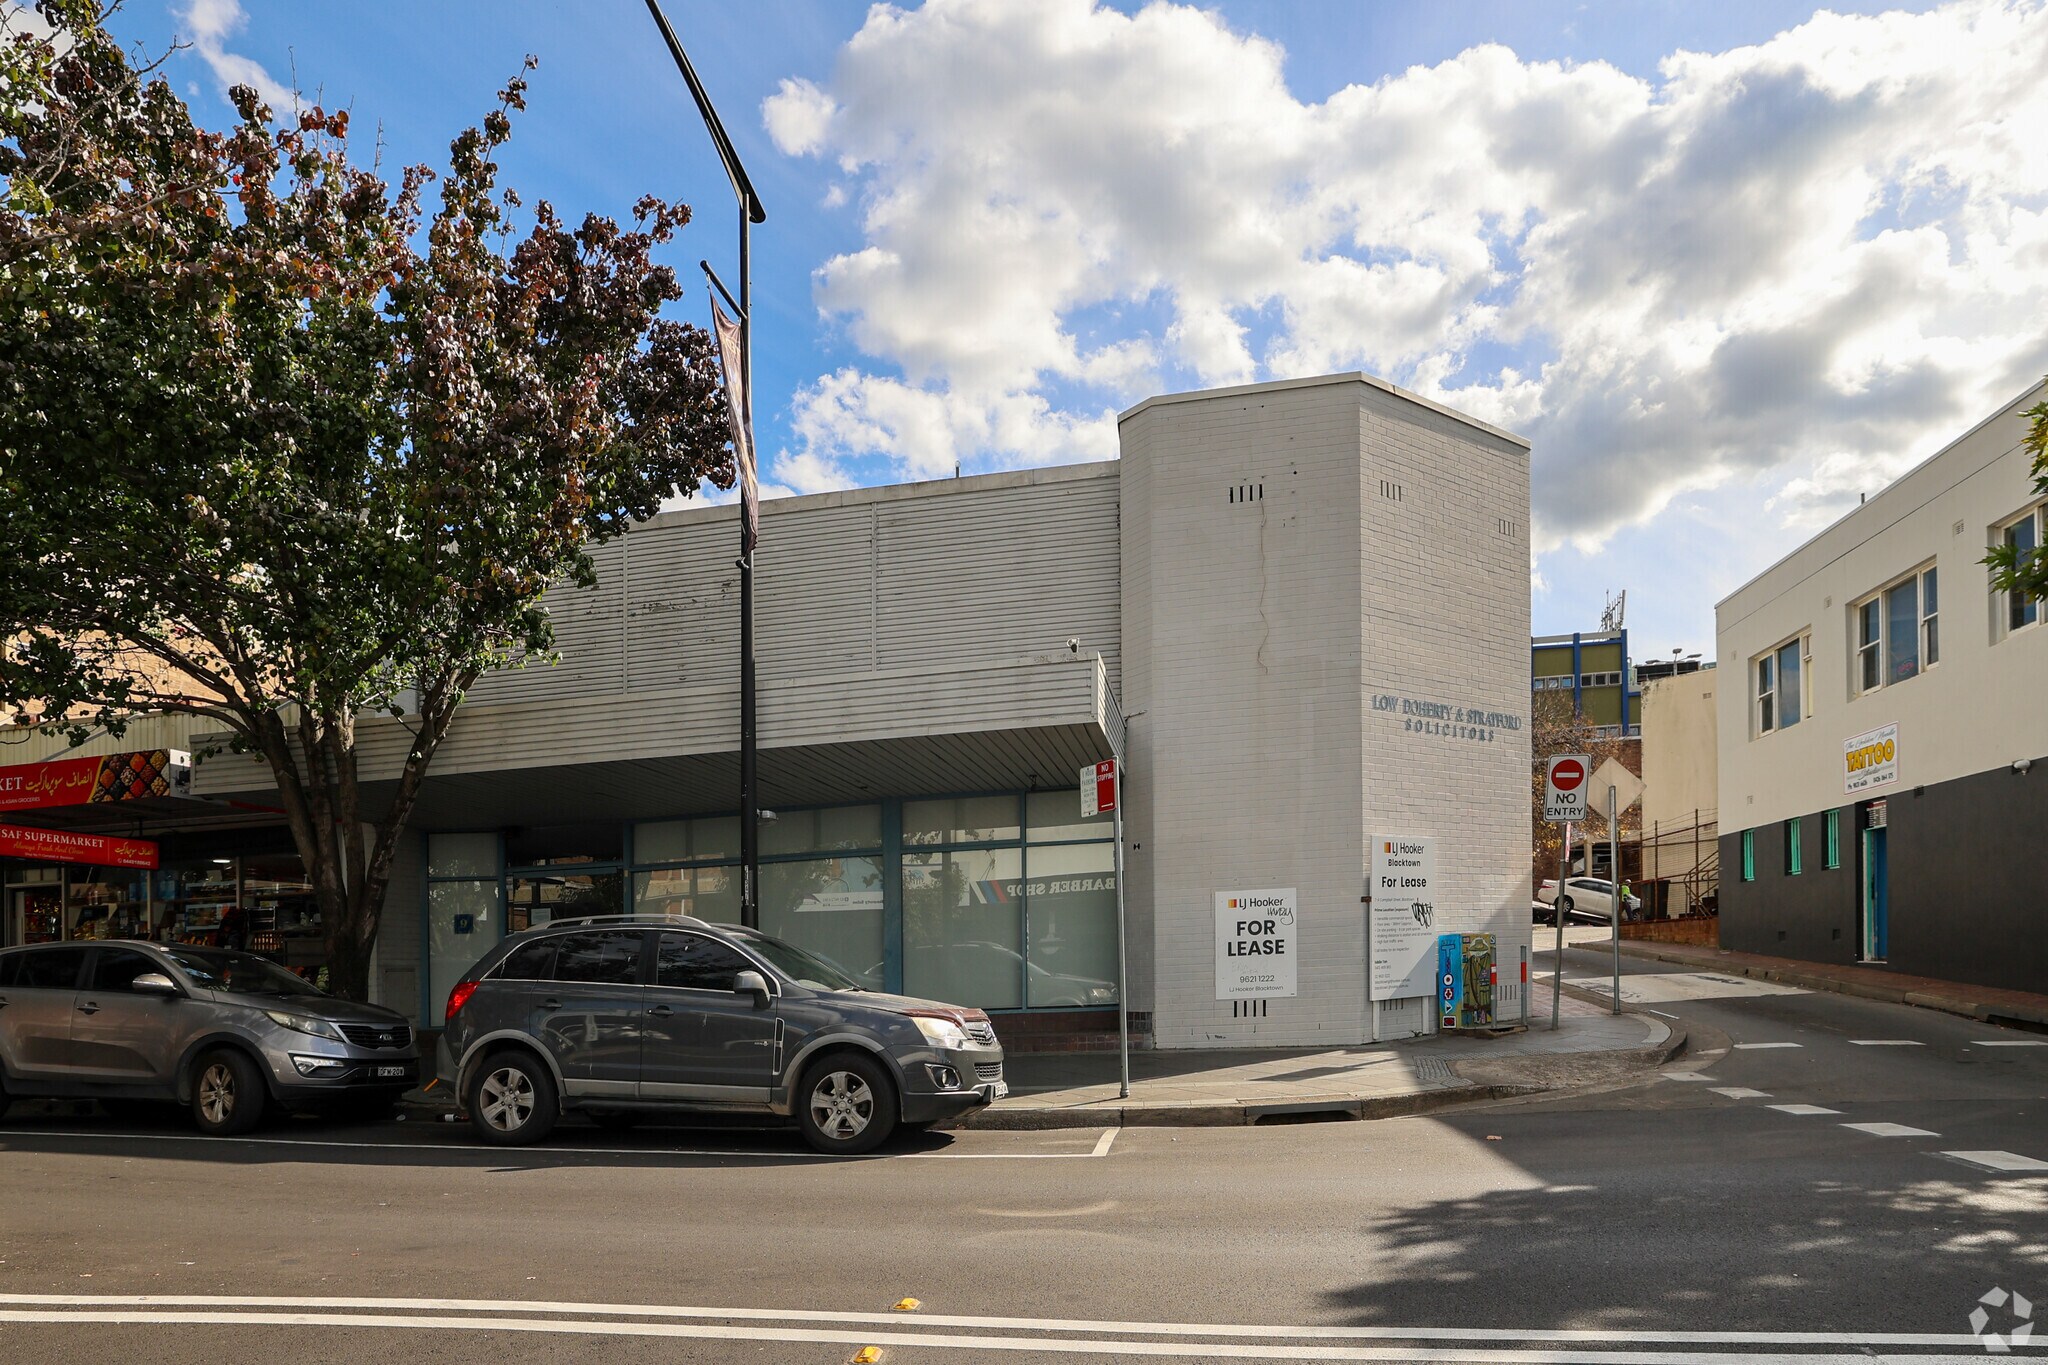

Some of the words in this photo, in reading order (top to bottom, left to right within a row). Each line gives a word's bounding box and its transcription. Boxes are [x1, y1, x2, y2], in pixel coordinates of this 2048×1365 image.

[1372, 695, 1398, 712] LOW
[1402, 698, 1453, 720] DOHERTY
[1455, 707, 1464, 722] &
[1467, 709, 1522, 730] STRATFORD
[1405, 718, 1495, 742] SOLICITORS
[1846, 738, 1895, 773] TATTOO
[1101, 763, 1109, 772] NO
[1097, 772, 1114, 782] STOPPING
[1556, 793, 1577, 804] NO
[1547, 807, 1584, 816] ENTRY
[0, 828, 23, 840] SAF
[25, 832, 104, 848] SUPERMARKET
[1392, 842, 1398, 857] LJ
[1400, 842, 1424, 854] Hooker
[1388, 858, 1421, 867] Blacktown
[1381, 876, 1397, 888] For
[1400, 876, 1427, 888] Lease
[1239, 898, 1247, 910] LJ
[1250, 897, 1284, 907] Hooker
[1237, 920, 1276, 936] FOR
[1227, 939, 1285, 956] LEASE
